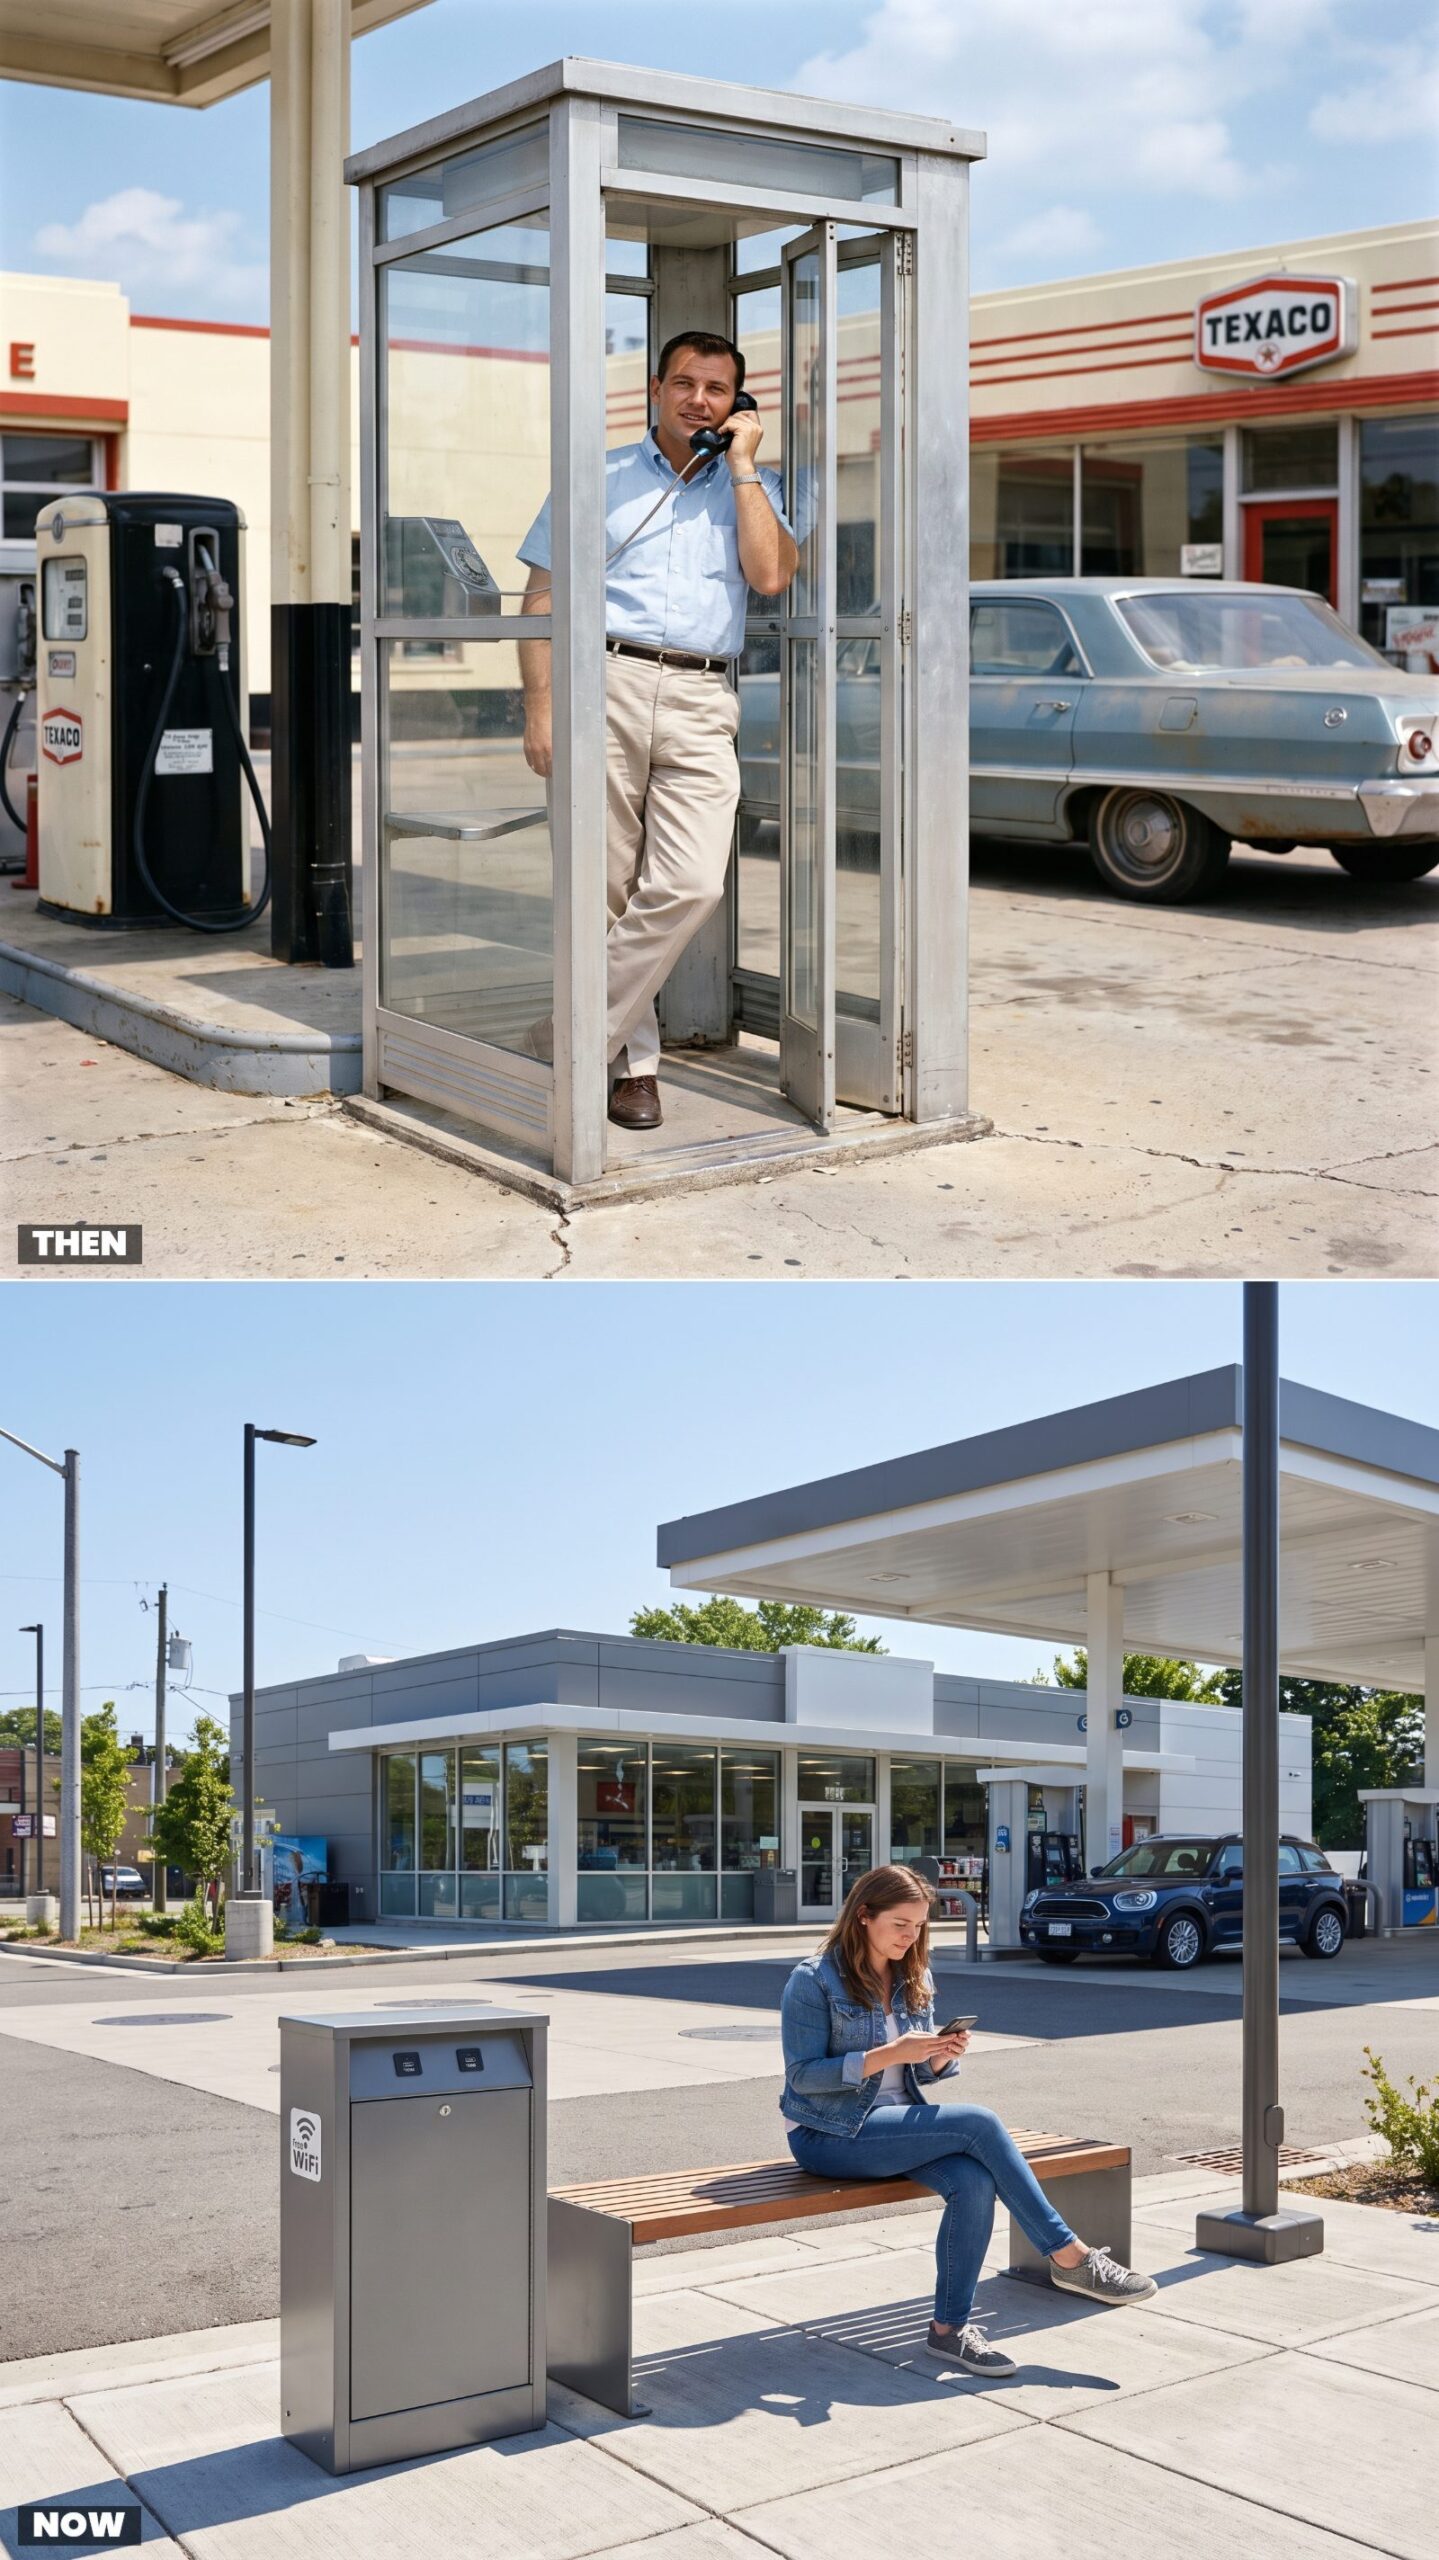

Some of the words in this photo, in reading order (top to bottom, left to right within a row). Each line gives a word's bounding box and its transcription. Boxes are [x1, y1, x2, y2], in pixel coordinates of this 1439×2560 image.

[1206, 302, 1330, 346] TEXACO
[10, 342, 35, 380] E
[44, 726, 80, 747] TEXACO
[293, 2149, 319, 2175] WiFi
